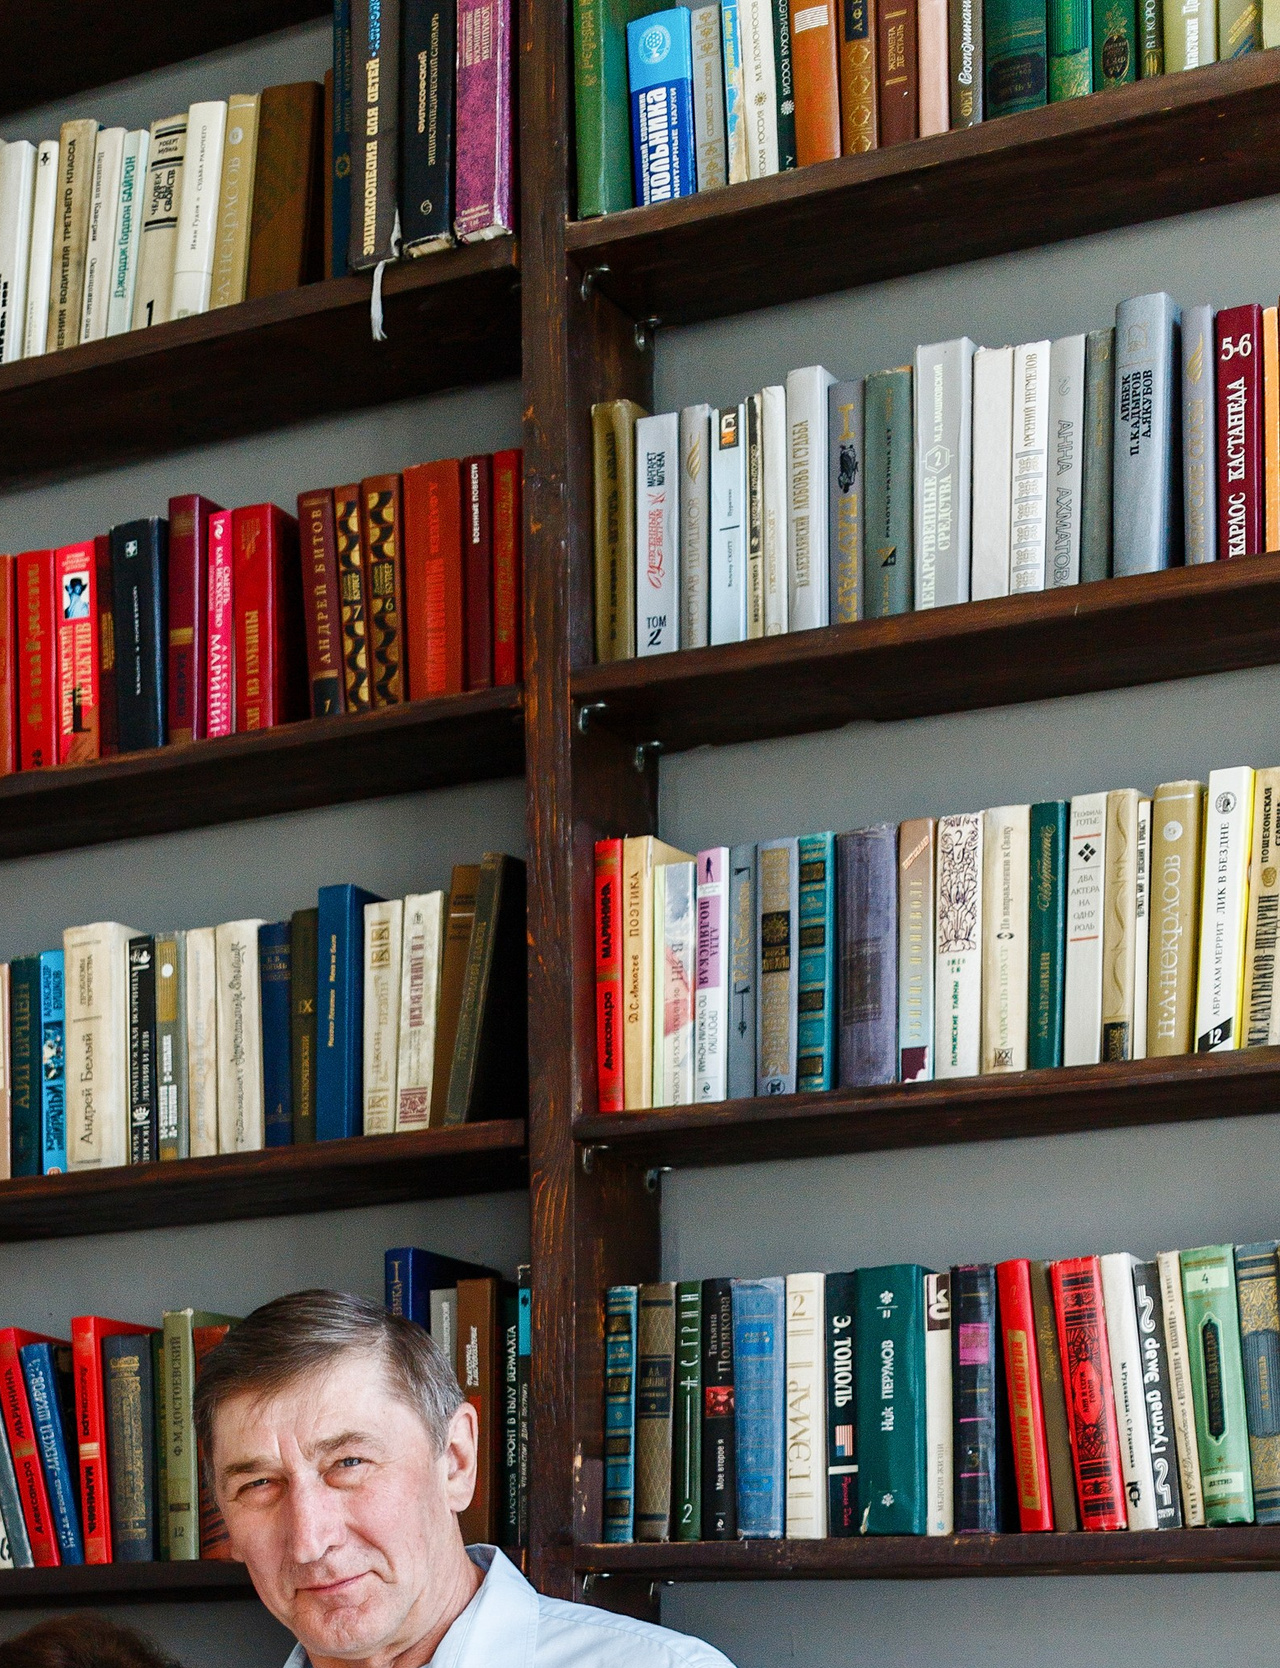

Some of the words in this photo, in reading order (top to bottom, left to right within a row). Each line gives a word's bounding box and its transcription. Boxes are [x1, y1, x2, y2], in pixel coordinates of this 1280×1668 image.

[429, 13, 439, 55] СЛОВАРЬ
[366, 57, 381, 103] ДЕТЕЙ
[366, 107, 379, 136] ДЛЯ
[121, 155, 136, 203] БАЙРОН
[362, 141, 378, 256] ЭНЦИКЛОПЕДИЯ
[1221, 333, 1252, 361] 5-6
[1120, 374, 1132, 423] АЙБЕК
[1226, 376, 1249, 483] КАСТАНЕДА
[470, 463, 480, 502] ПОВЕСТИ
[646, 451, 657, 488] МАРГАРЕТ
[936, 473, 953, 551] СРЕДСТВА
[1227, 491, 1247, 557] КАРЛОС
[310, 508, 326, 573] БИТОВ
[314, 583, 332, 665] АНДРЕЙ
[646, 615, 667, 629] ТОМ
[647, 628, 662, 647] 2
[1218, 821, 1231, 873] БЕЗДНЕ
[1215, 887, 1227, 915] ЛИК
[1217, 875, 1227, 884] В
[698, 900, 710, 985] ПОЛЯНСКАЯ
[1214, 921, 1225, 965] МЕРРИТ
[1212, 966, 1223, 1017] АБРАХАМ
[79, 1032, 94, 1083] Белый
[698, 1042, 707, 1073] НОЧАМ
[80, 1087, 96, 1146] Андрей
[506, 1325, 517, 1383] ВЕРМАХТА
[708, 1313, 719, 1357] Татьяна
[834, 1338, 852, 1408] ТОПОЛЬ
[3, 1367, 26, 1440] МАРИНИНА
[506, 1385, 517, 1415] ТЫЛУ
[506, 1428, 517, 1468] ФРОНТ
